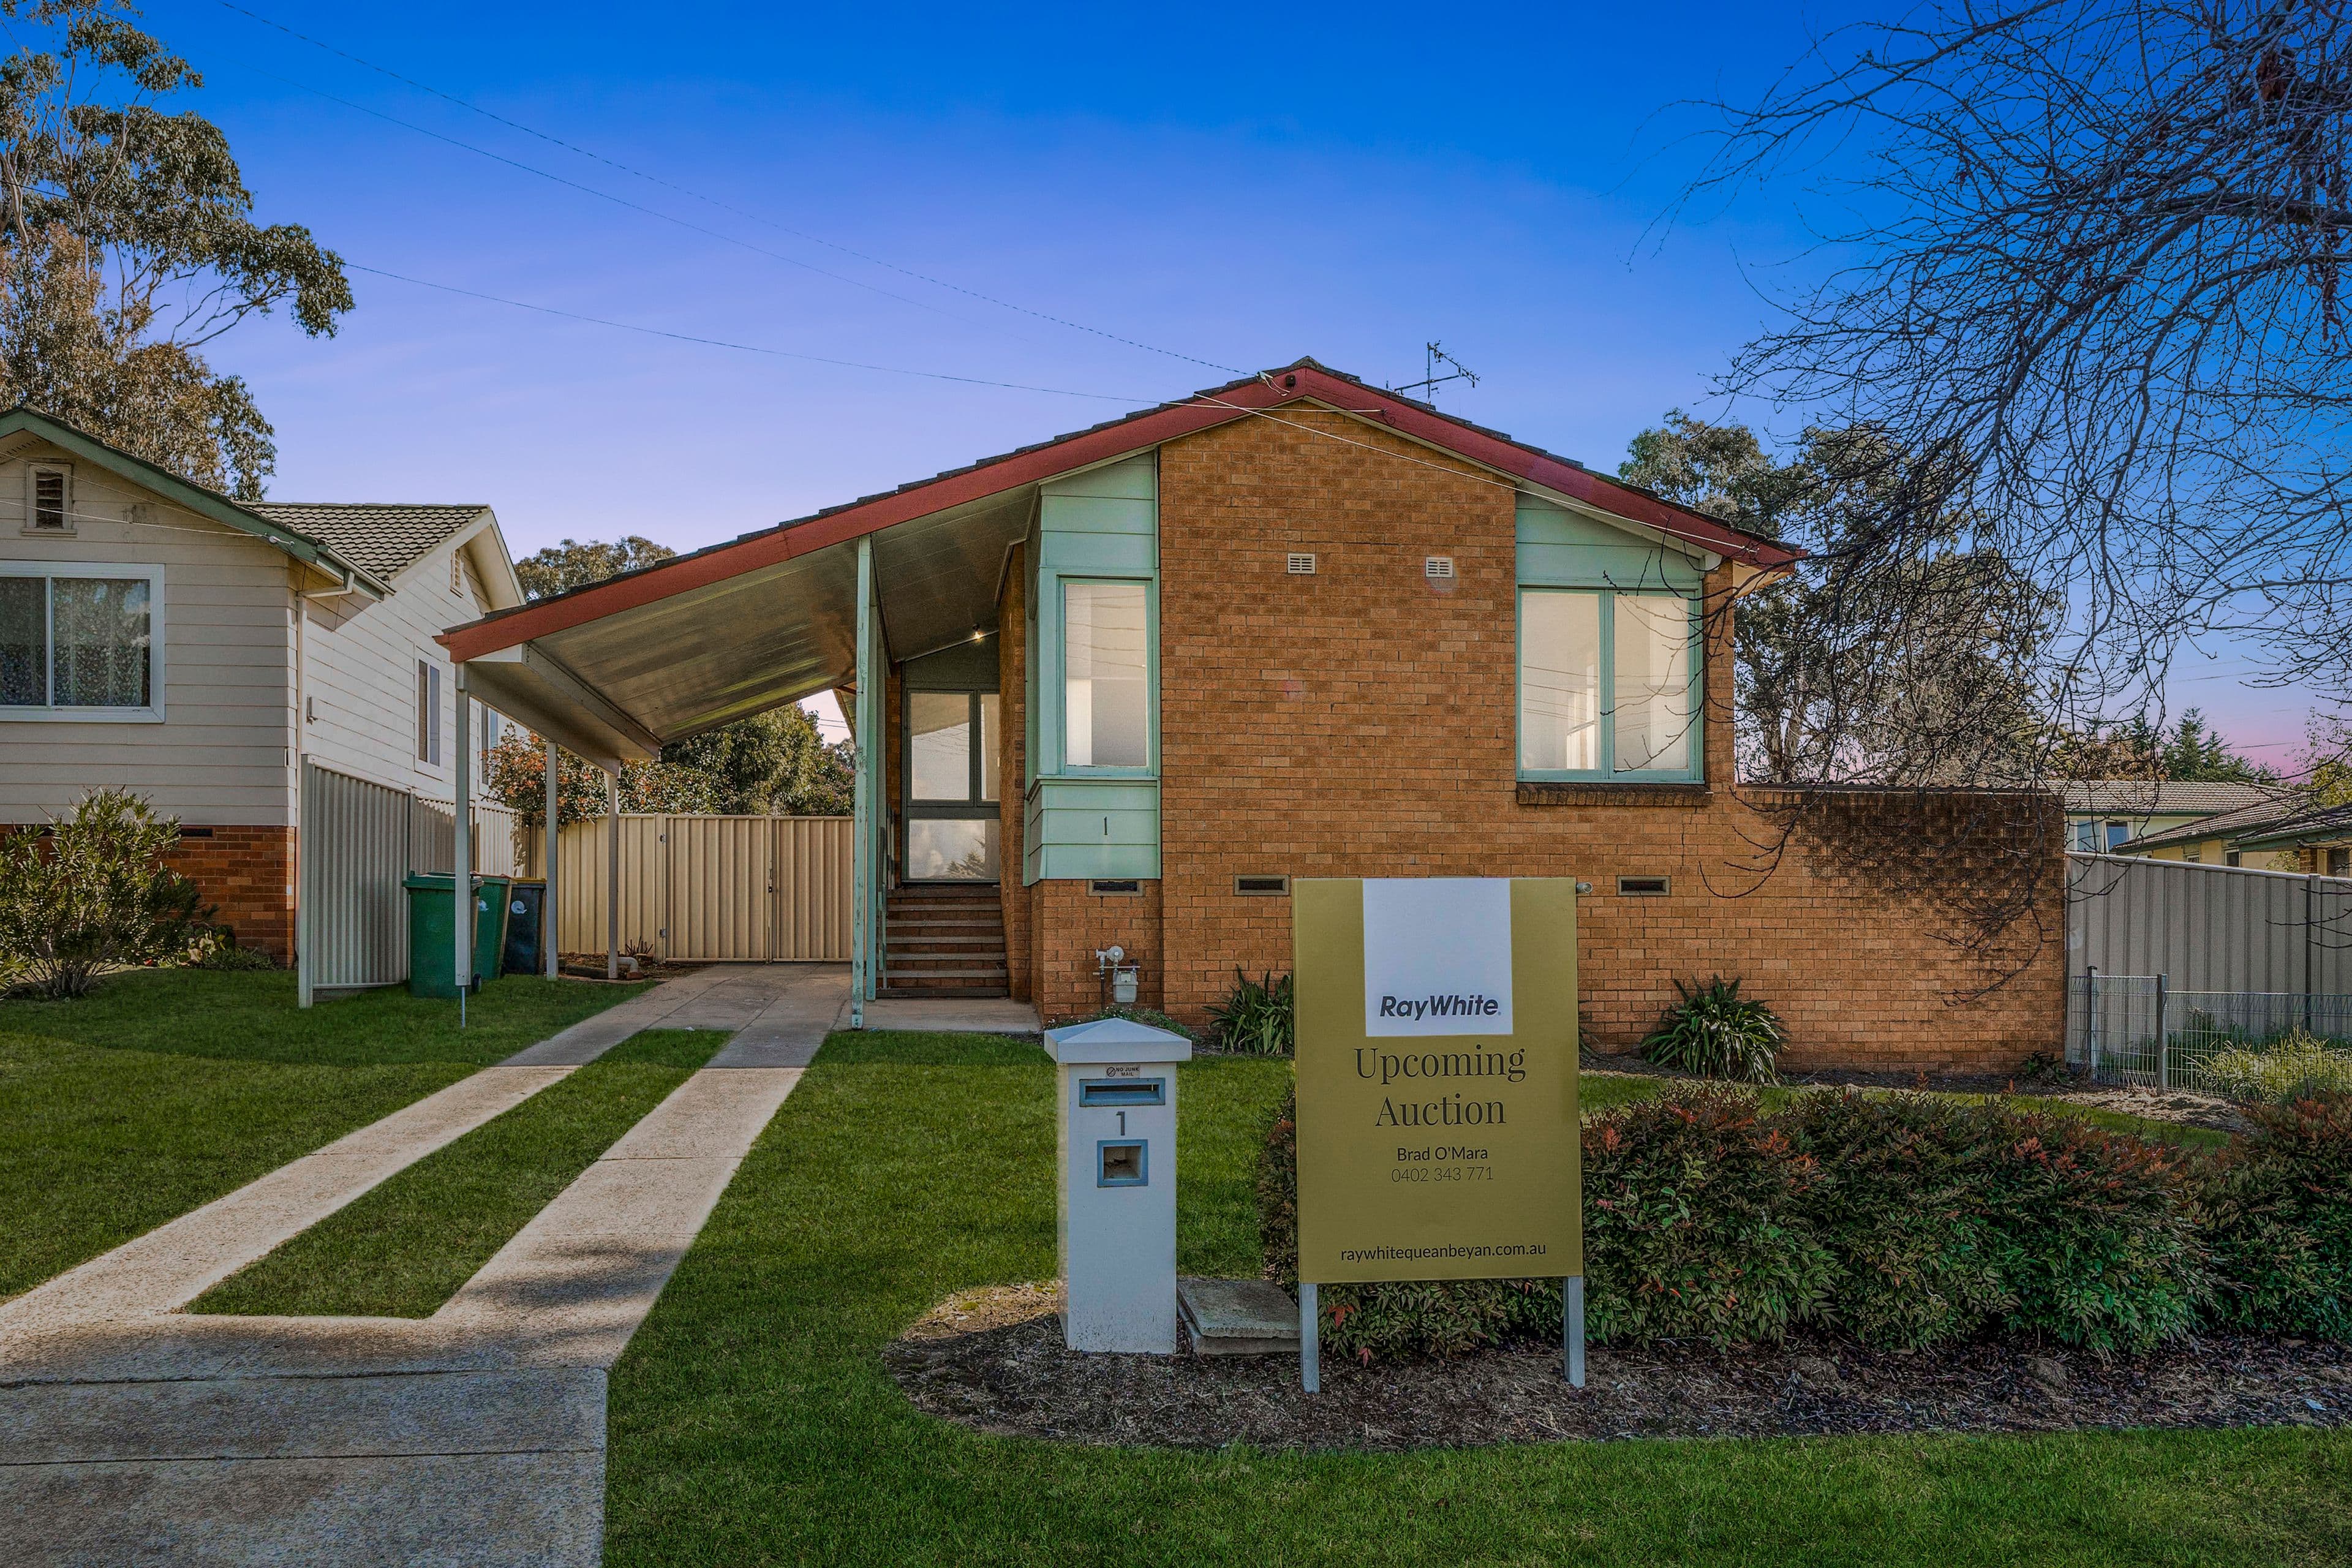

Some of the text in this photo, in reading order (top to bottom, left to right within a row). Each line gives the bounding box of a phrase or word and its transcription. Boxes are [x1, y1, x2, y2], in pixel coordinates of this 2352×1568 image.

[1104, 816, 1108, 835] 1
[1354, 1044, 1526, 1085] Upcoming
[1375, 1093, 1506, 1126] Auction
[1116, 1111, 1125, 1136] 1
[1397, 1146, 1488, 1161] Brad O'Mara
[1391, 1166, 1494, 1183] 0402 343 771
[1341, 1243, 1547, 1263] raywhitequeanbeyan.com.au
